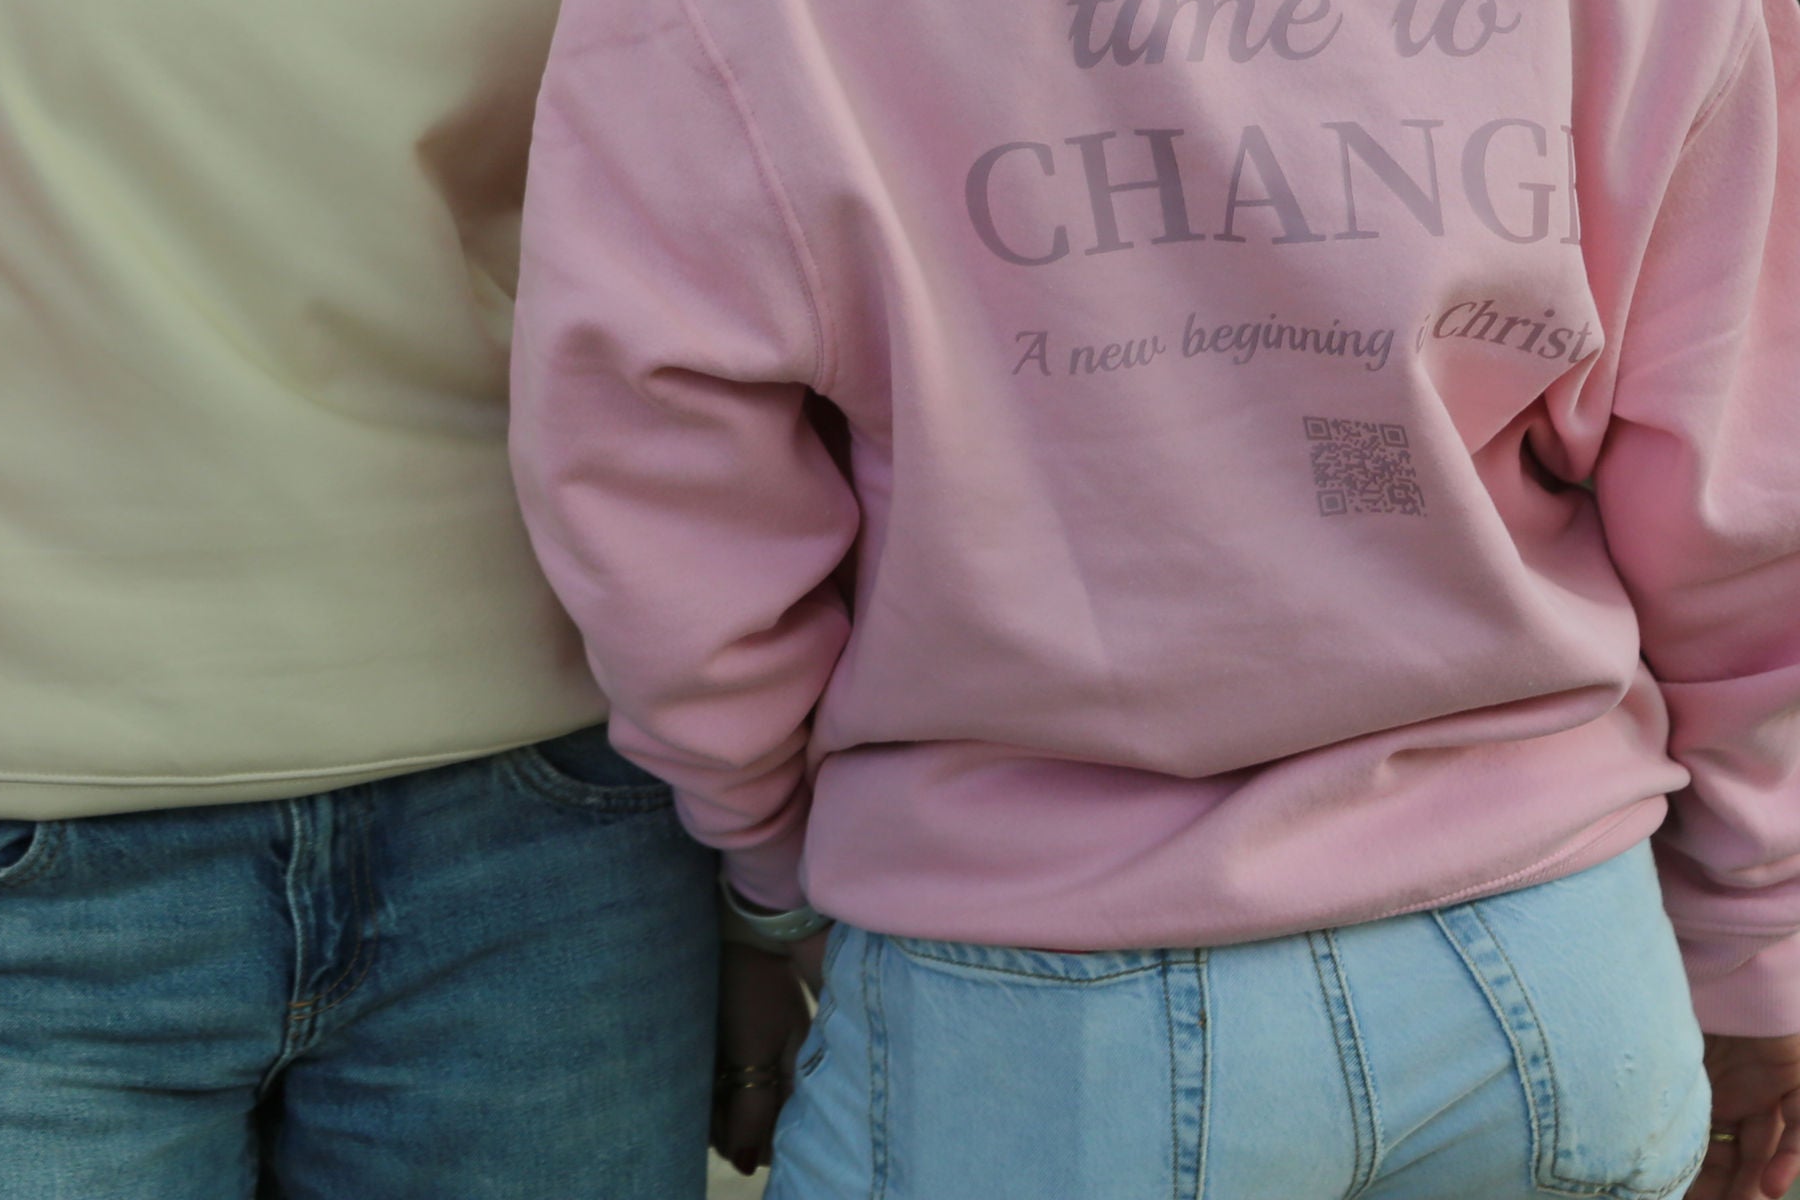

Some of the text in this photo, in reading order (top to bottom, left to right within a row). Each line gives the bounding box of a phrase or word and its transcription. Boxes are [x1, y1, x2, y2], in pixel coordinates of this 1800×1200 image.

[963, 117, 1581, 267] CHANG
[1012, 330, 1053, 377] A
[1068, 335, 1166, 376] new
[1181, 312, 1395, 371] beginning
[1432, 299, 1593, 364] Christ
